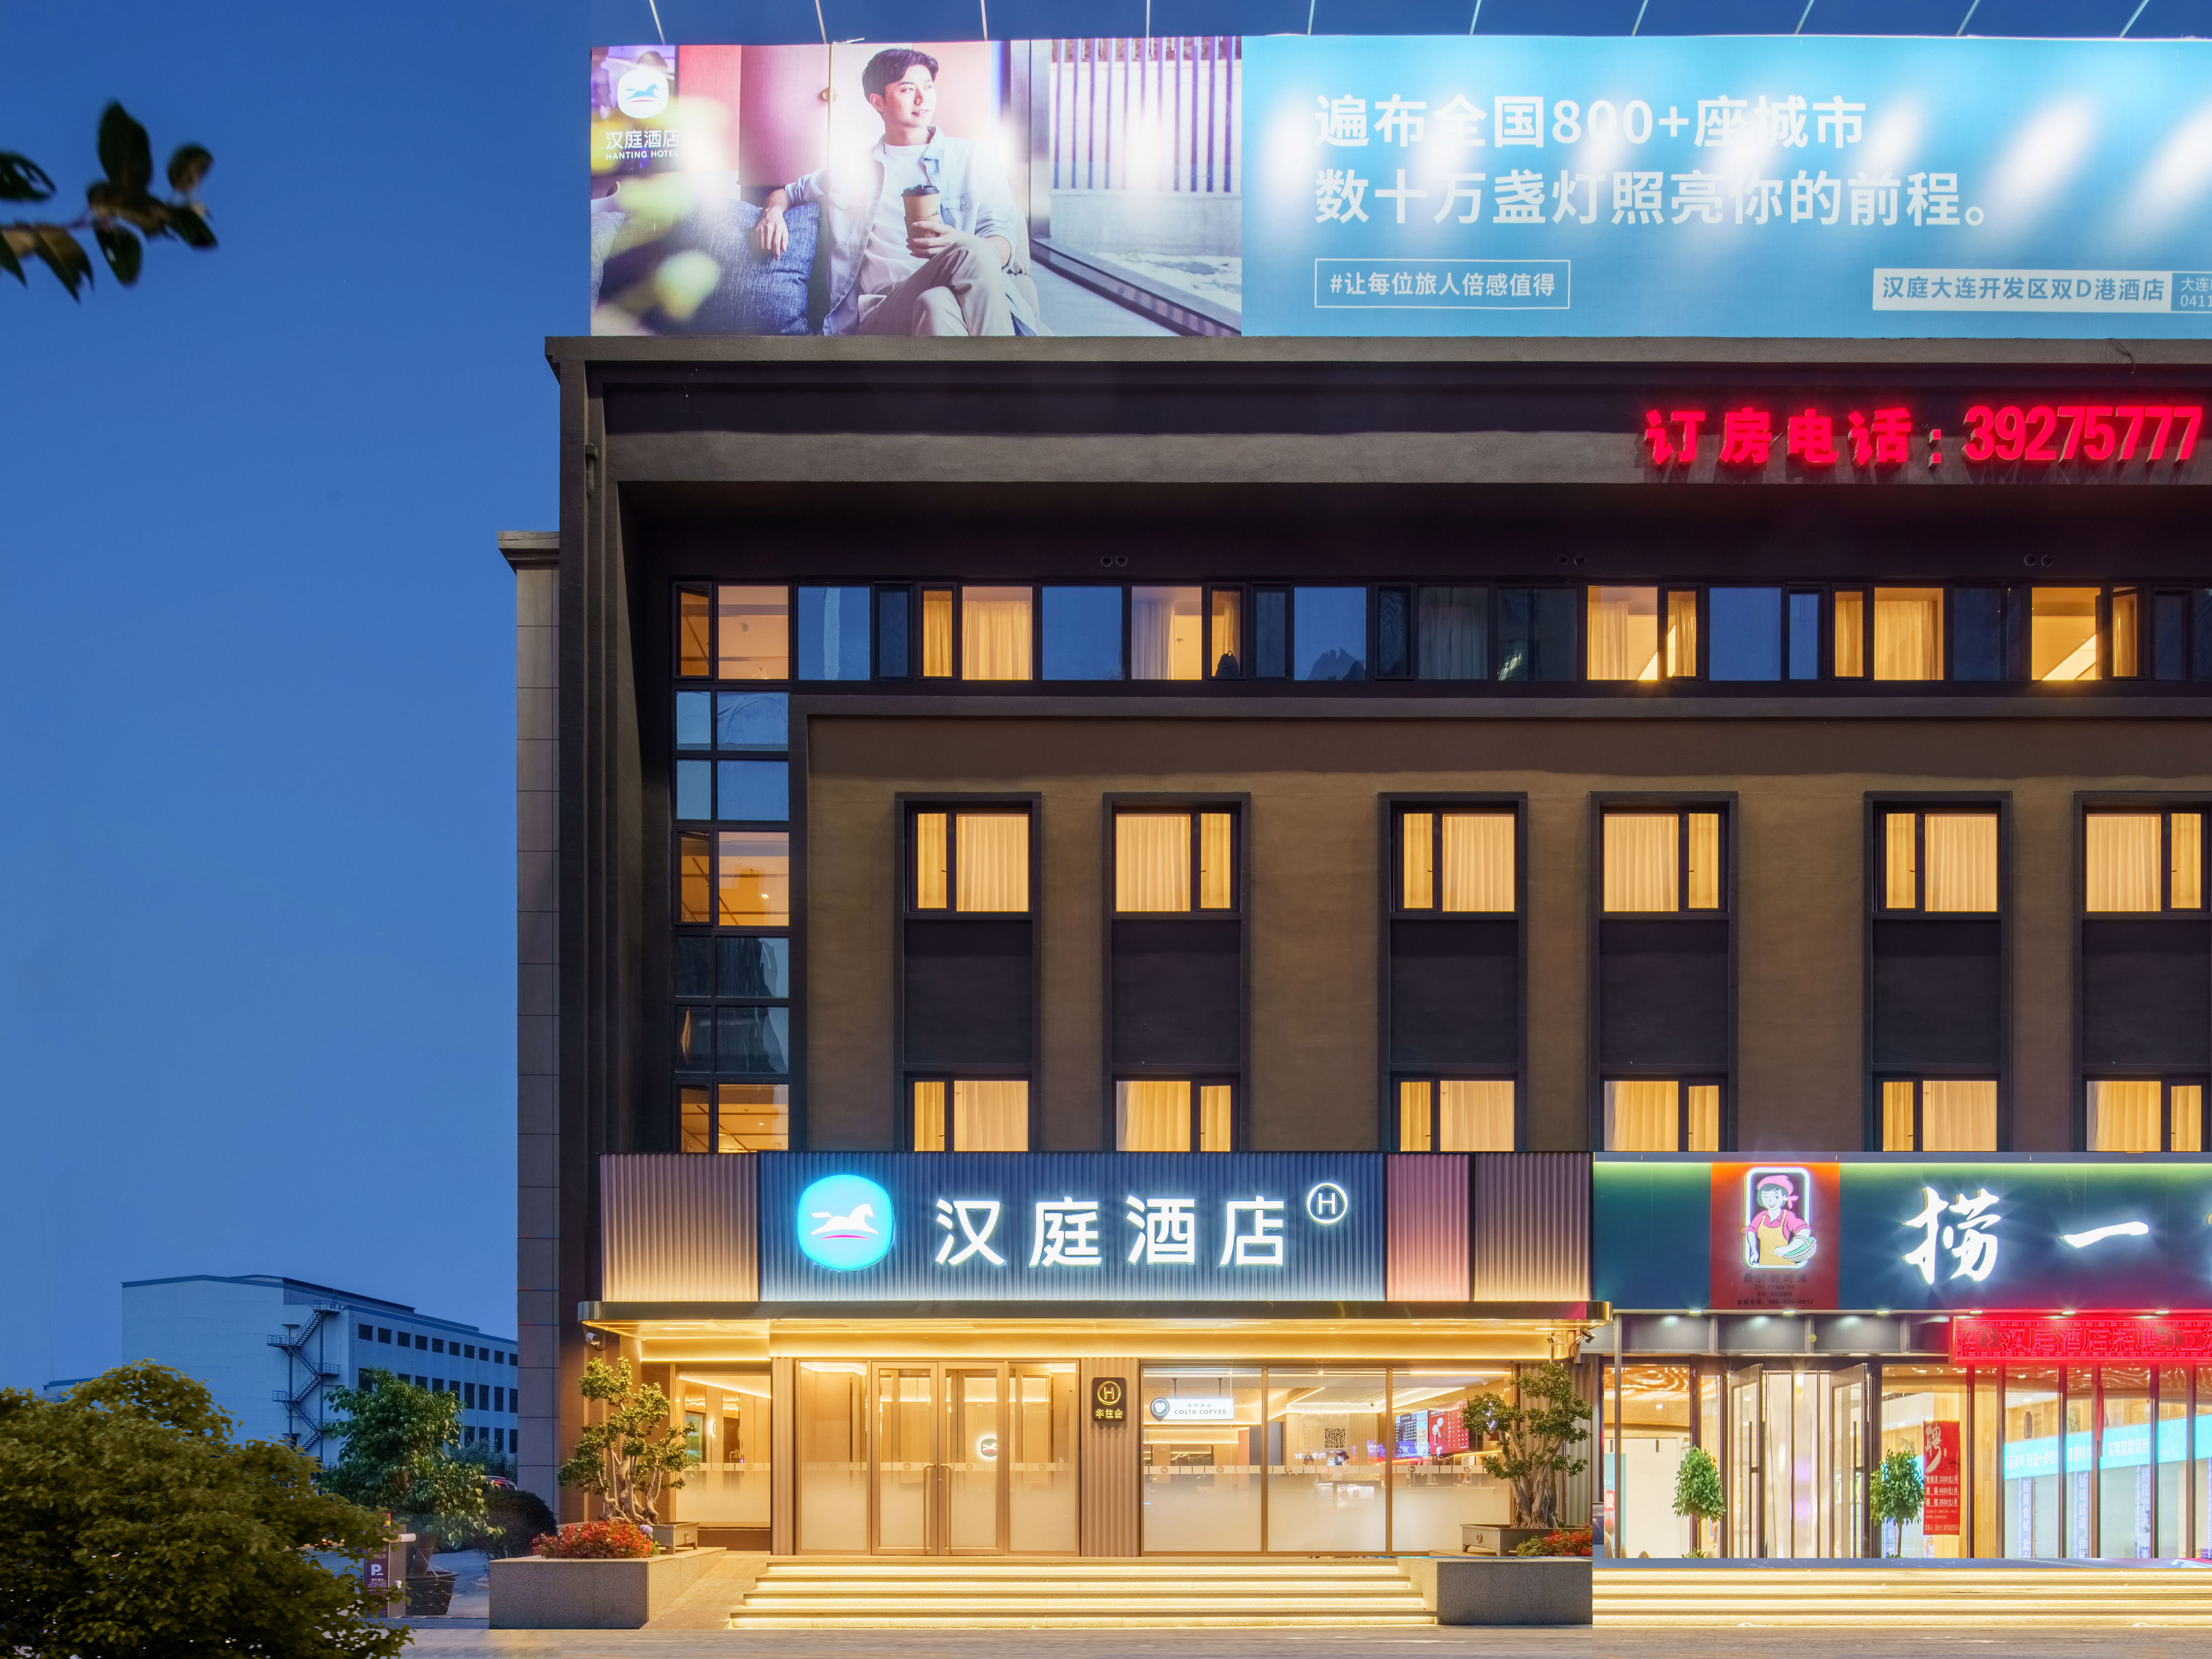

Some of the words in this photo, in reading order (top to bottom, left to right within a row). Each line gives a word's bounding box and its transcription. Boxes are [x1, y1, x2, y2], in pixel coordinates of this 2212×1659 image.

[1314, 93, 1866, 148] 遍布全国800+座城市
[606, 129, 680, 150] 汉庭酒店
[606, 151, 648, 160] HANTING
[1314, 169, 1985, 227] 数十万盏灯照亮你的前程。
[1330, 272, 1556, 297] #让每位旅人倍感值得
[1882, 276, 2164, 301] 汉庭大连开发区双D港酒店
[2181, 276, 2212, 291] 大连
[934, 1194, 1286, 1267] 汉庭酒店
[1902, 1186, 2212, 1285] 捞一
[1095, 1408, 1123, 1419] 华住会
[371, 1564, 382, 1576] P
